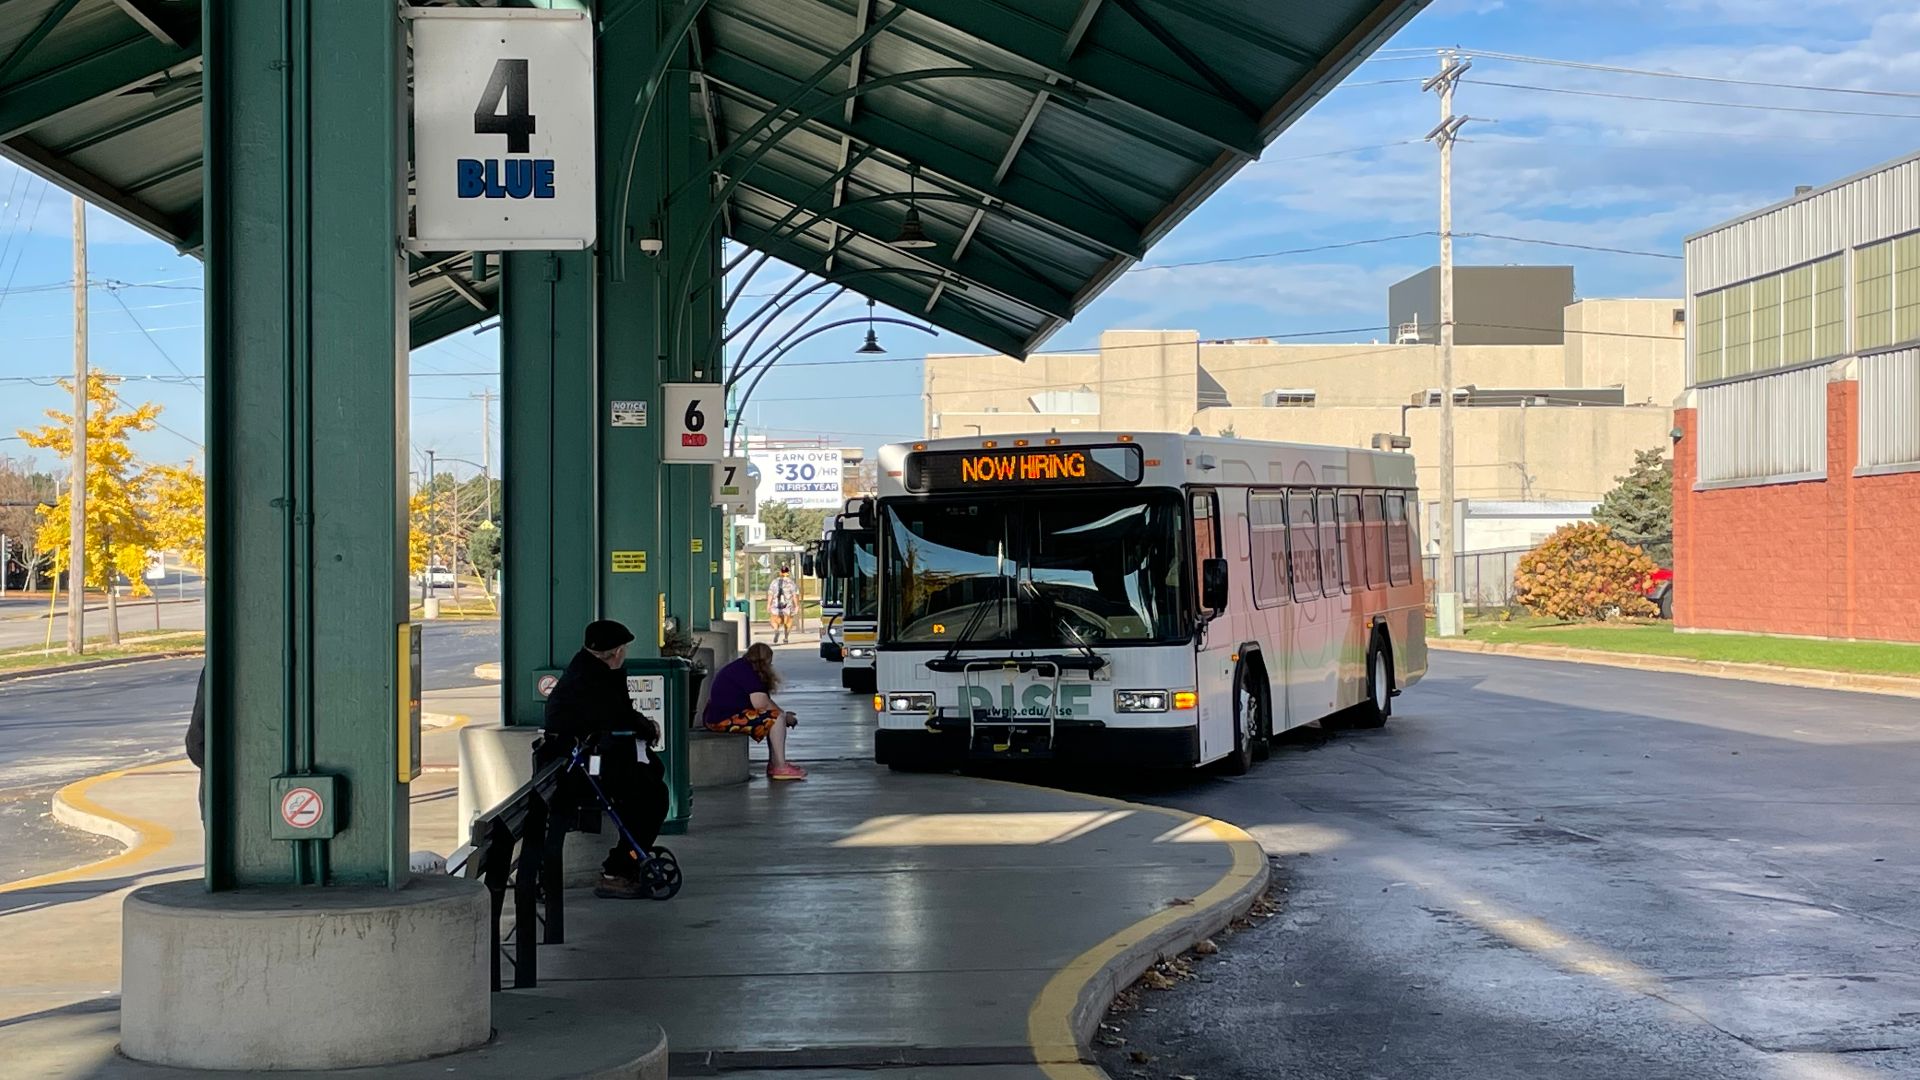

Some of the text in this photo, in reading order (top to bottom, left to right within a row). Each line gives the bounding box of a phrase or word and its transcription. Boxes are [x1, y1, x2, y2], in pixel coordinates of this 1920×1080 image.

[474, 59, 536, 153] 4
[457, 159, 555, 198] BLUE
[612, 402, 646, 410] NOTICE
[684, 400, 705, 432] 6
[681, 433, 708, 447] RED
[775, 453, 805, 462] EARN
[807, 453, 838, 462] OVER
[962, 452, 1086, 482] NOW HIRING
[724, 466, 737, 486] 7
[986, 705, 1073, 719] uwgb.edu/ise
